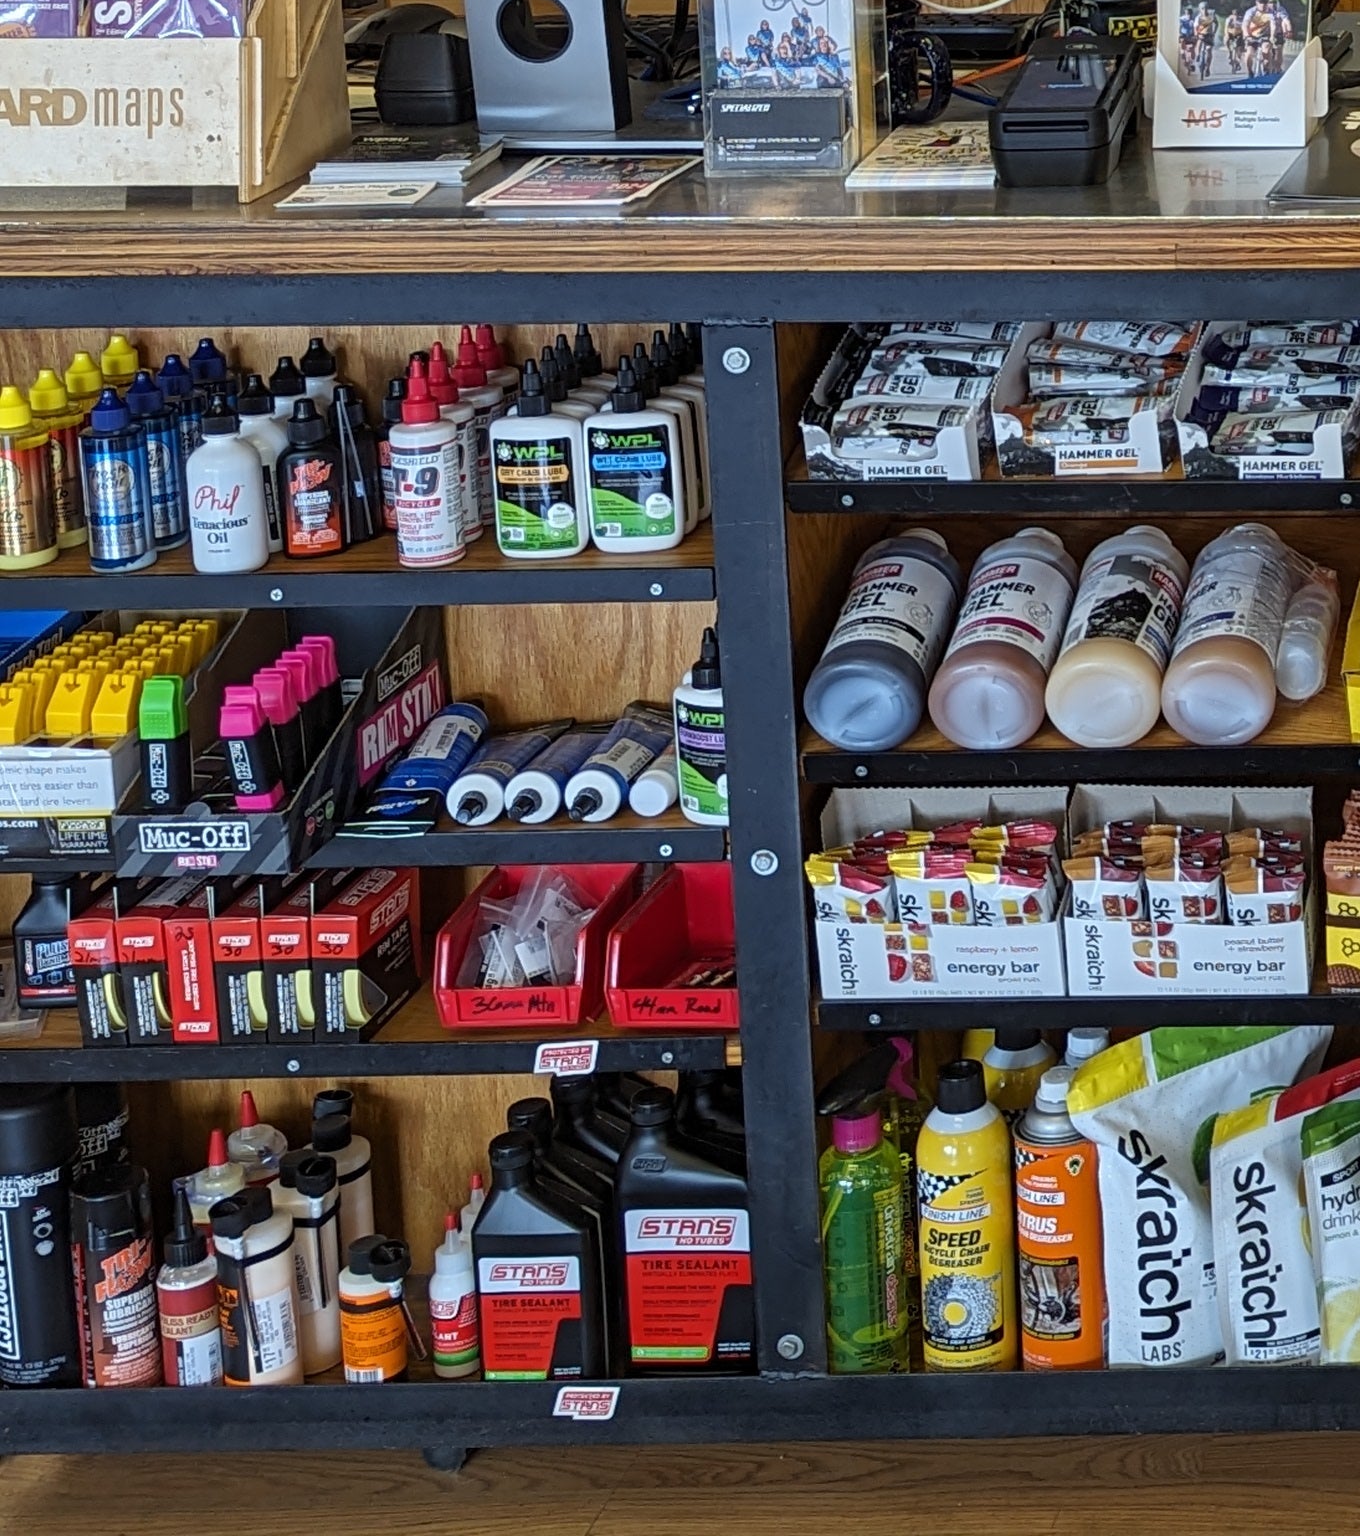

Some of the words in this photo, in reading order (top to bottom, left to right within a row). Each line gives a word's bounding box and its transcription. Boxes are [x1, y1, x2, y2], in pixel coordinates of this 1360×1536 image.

[93, 85, 185, 141] maps
[610, 434, 661, 447] WPL
[513, 446, 564, 458] WPL
[1058, 449, 1108, 461] HAMMER
[1111, 447, 1139, 459] GEL
[867, 465, 920, 476] HAMMER
[923, 465, 948, 476] GEL
[1242, 461, 1292, 472] HAMMER
[1295, 460, 1321, 471] GEL
[194, 485, 240, 516] Phil
[191, 516, 248, 530] Tenacious
[207, 531, 228, 545] Oil
[361, 720, 400, 772] RIM
[402, 666, 445, 729] STIX
[58, 831, 108, 842] LIFETIME
[144, 825, 246, 849] Muc-Off
[57, 840, 109, 850] WARRANTY
[320, 942, 344, 956] 30
[947, 961, 1006, 978] energy
[1010, 960, 1040, 975] bar
[1193, 959, 1252, 977] energy
[1257, 958, 1286, 974] bar
[541, 1054, 592, 1068] STANS
[642, 1217, 735, 1236] STANS
[928, 1229, 981, 1248] SPEED
[1117, 1128, 1193, 1343] skratch
[1233, 1161, 1289, 1348] skratch
[641, 1259, 673, 1270] TIRE
[676, 1259, 739, 1270] SEALANT
[492, 1299, 518, 1308] TIRE
[520, 1298, 571, 1307] SEALANT
[1141, 1343, 1183, 1362] LABS
